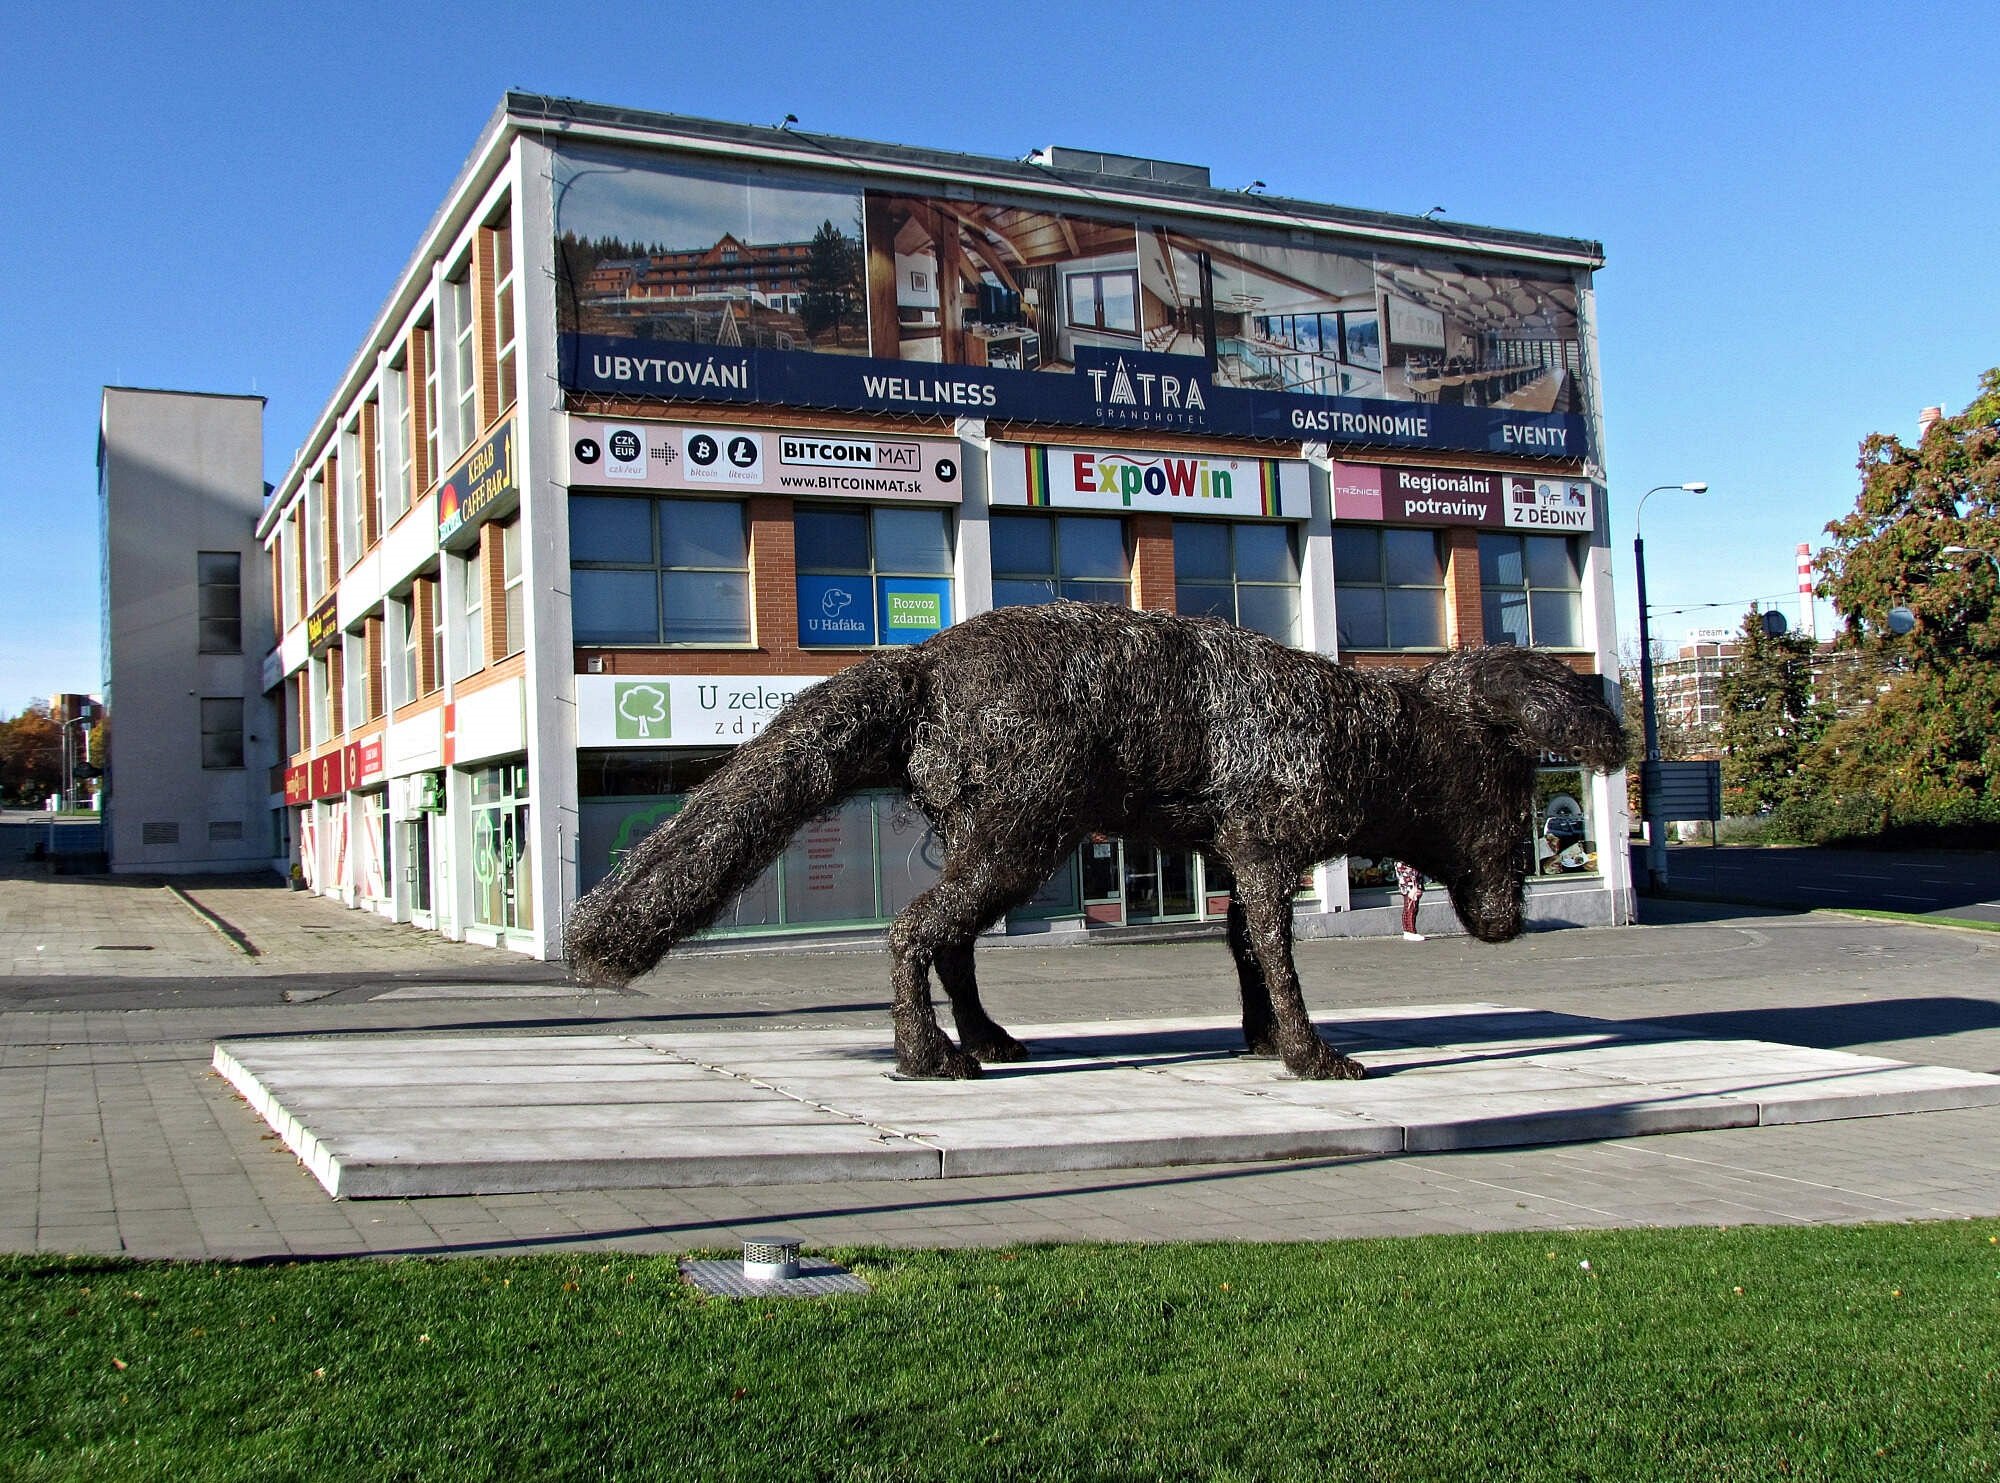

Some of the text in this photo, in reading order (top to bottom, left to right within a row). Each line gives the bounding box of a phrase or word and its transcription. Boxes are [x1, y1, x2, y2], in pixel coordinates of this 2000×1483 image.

[594, 355, 748, 389] UBYTOVÁNÍ
[863, 375, 997, 406] WELLNESS
[1096, 408, 1205, 425] GRANDHOTEL
[1291, 409, 1428, 437] GASTRONOMIE
[614, 435, 635, 445] CZK
[1503, 425, 1567, 447] EVENTY
[615, 447, 635, 457] EUR
[784, 442, 916, 465] BITCOIN MAT
[468, 442, 495, 486] KEBAB
[690, 468, 718, 478] bitcoin
[728, 470, 758, 480] litecoin
[780, 476, 922, 493] www.BITCOINMAT.sk
[1072, 453, 1233, 507] ExpoWin
[1399, 472, 1490, 494] Regionální
[462, 469, 504, 522] CAFFÉ BAR
[1336, 485, 1381, 496] TRŽNICE
[1405, 499, 1487, 521] potraviny
[1513, 505, 1587, 526] Z DĚDINY
[893, 597, 935, 609] Rozvoz
[808, 618, 866, 632] U Hafáka
[893, 612, 937, 625] zdarma
[697, 685, 797, 710] U zelen
[715, 715, 761, 735] zdr
